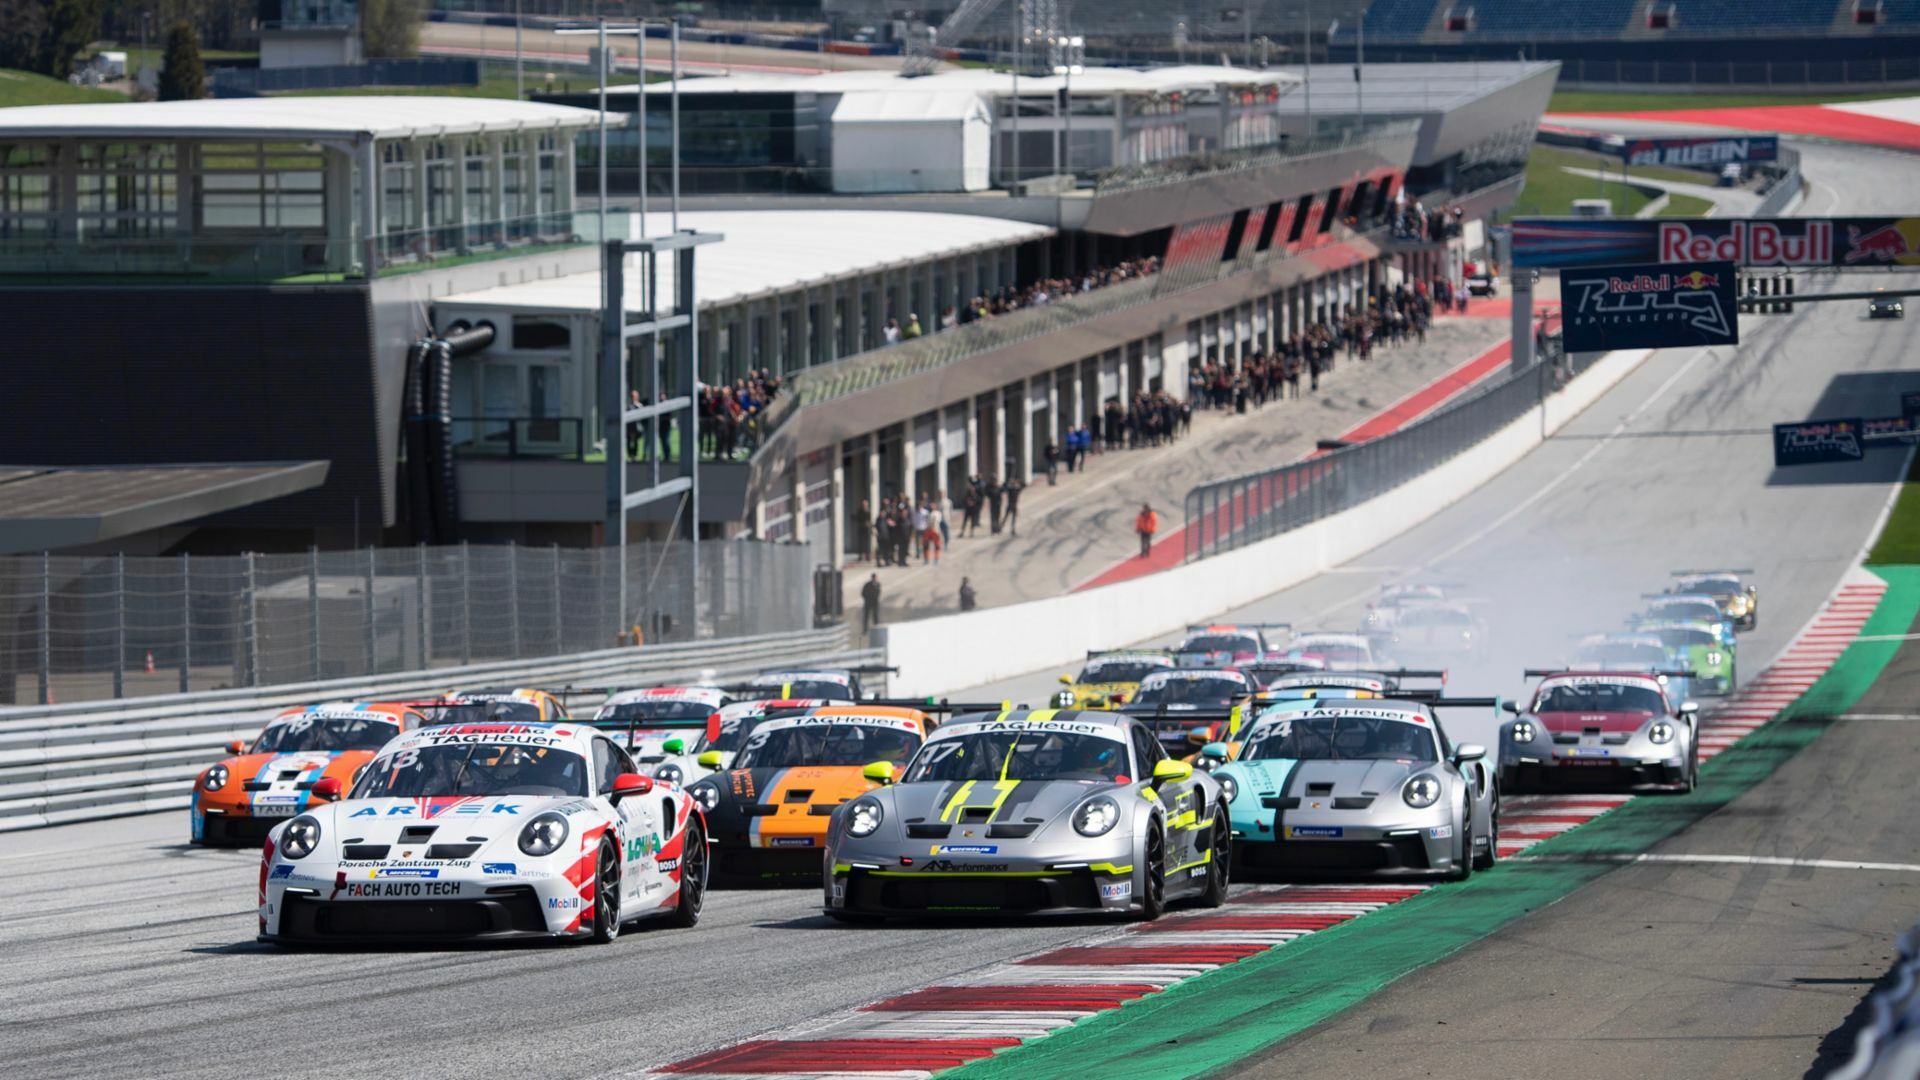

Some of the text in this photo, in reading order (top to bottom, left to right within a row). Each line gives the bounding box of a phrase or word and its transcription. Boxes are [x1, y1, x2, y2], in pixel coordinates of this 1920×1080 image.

[1250, 721, 1292, 743] 34
[748, 731, 771, 750] 3
[922, 742, 964, 764] 17
[377, 748, 421, 773] 13
[348, 803, 522, 818] ARTEK
[338, 859, 472, 869] Porsche Zentrum Zug
[659, 859, 676, 871] BOSS
[348, 882, 461, 896] FACH AUTO TECH
[1103, 885, 1125, 897] Mobil
[548, 898, 572, 909] Mobil
